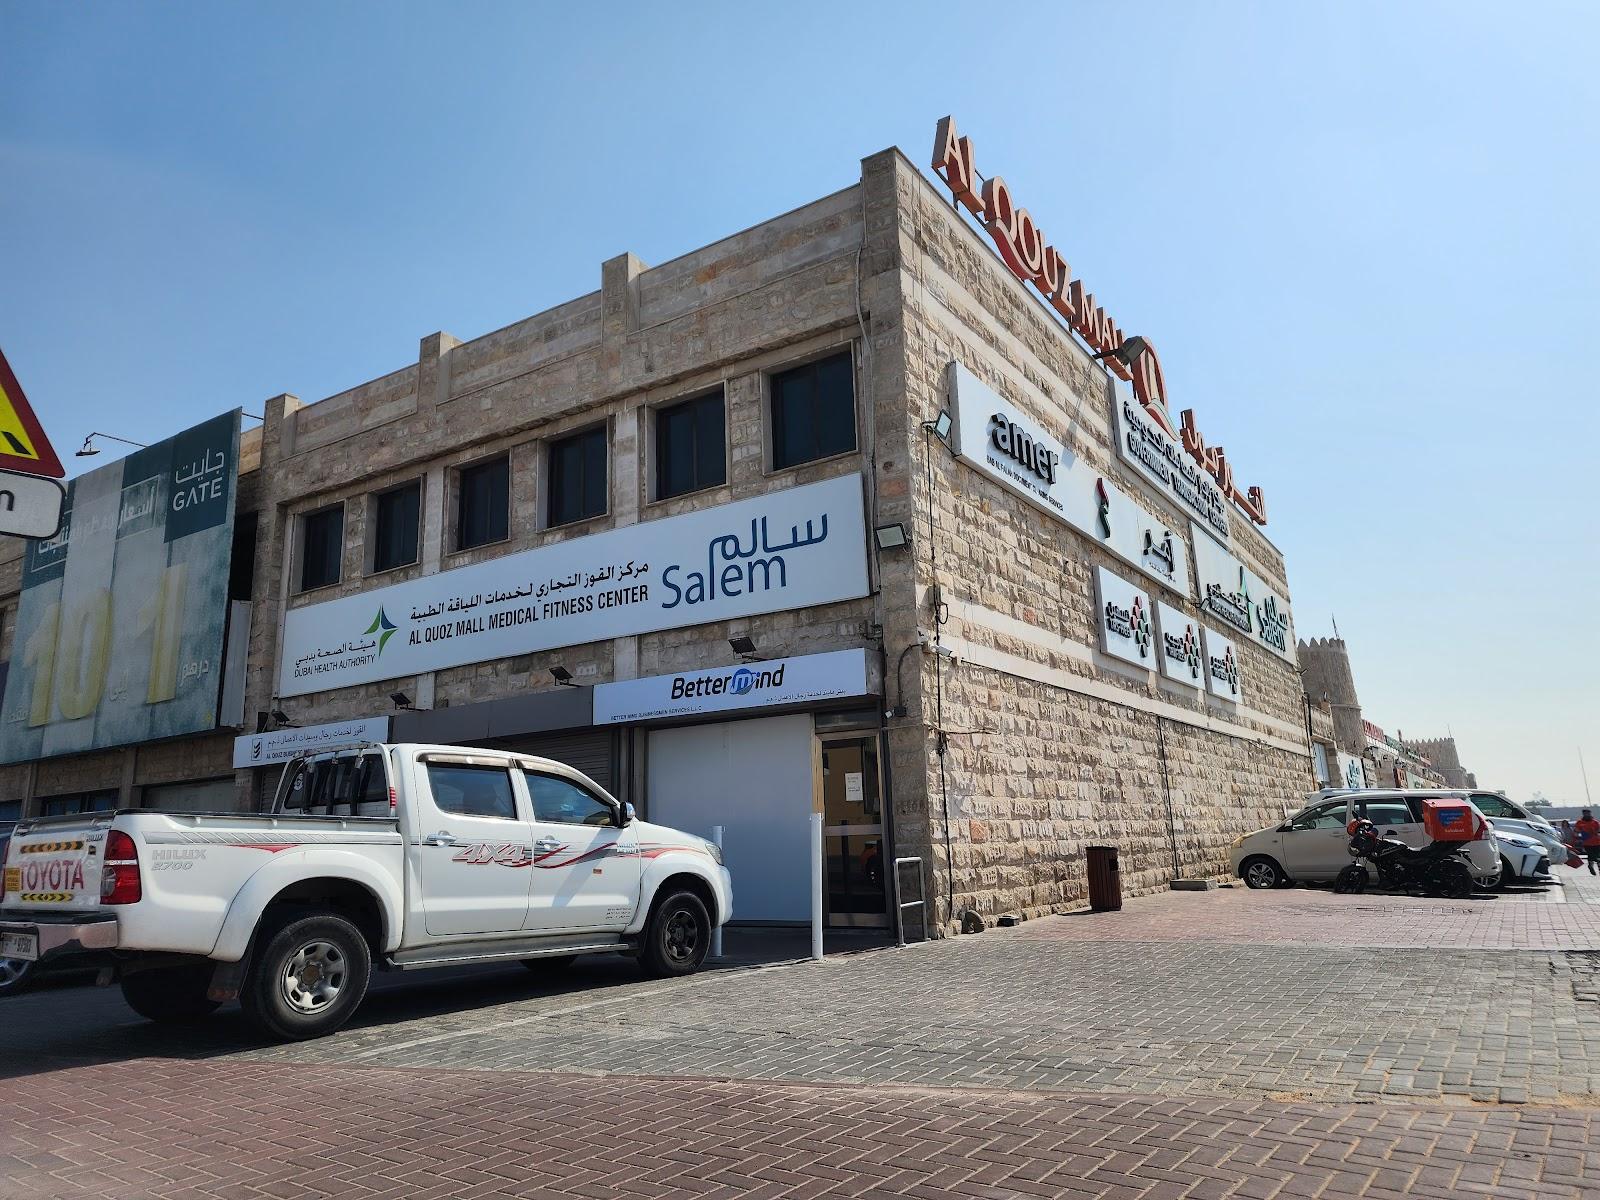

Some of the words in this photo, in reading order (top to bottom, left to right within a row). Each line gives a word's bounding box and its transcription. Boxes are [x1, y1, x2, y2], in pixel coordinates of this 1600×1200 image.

[931, 115, 987, 214] AL
[988, 412, 1059, 485] amer
[172, 476, 223, 512] GATE
[709, 513, 828, 582] سالم
[583, 565, 615, 589] القوز
[617, 560, 649, 581] مركز
[661, 548, 788, 609] Salem
[485, 583, 533, 605] لخدمات
[536, 573, 581, 602] التجاري
[409, 630, 422, 646] AL
[425, 622, 453, 643] QUOZ
[456, 617, 485, 636] MALL
[489, 606, 539, 630] MEDICAL
[543, 595, 593, 620] FITNESS
[598, 584, 649, 609] CENTER
[410, 602, 445, 623] الطبية
[447, 593, 482, 613] اللياقة
[317, 643, 347, 658] الصحة
[348, 638, 377, 652] هيئة
[294, 666, 313, 678] DUBAI
[315, 661, 338, 674] HEALTH
[339, 654, 376, 669] AUTHORITY
[295, 653, 316, 668] بدبي
[151, 848, 208, 861] HILUX
[21, 859, 85, 892] TOYOTA
